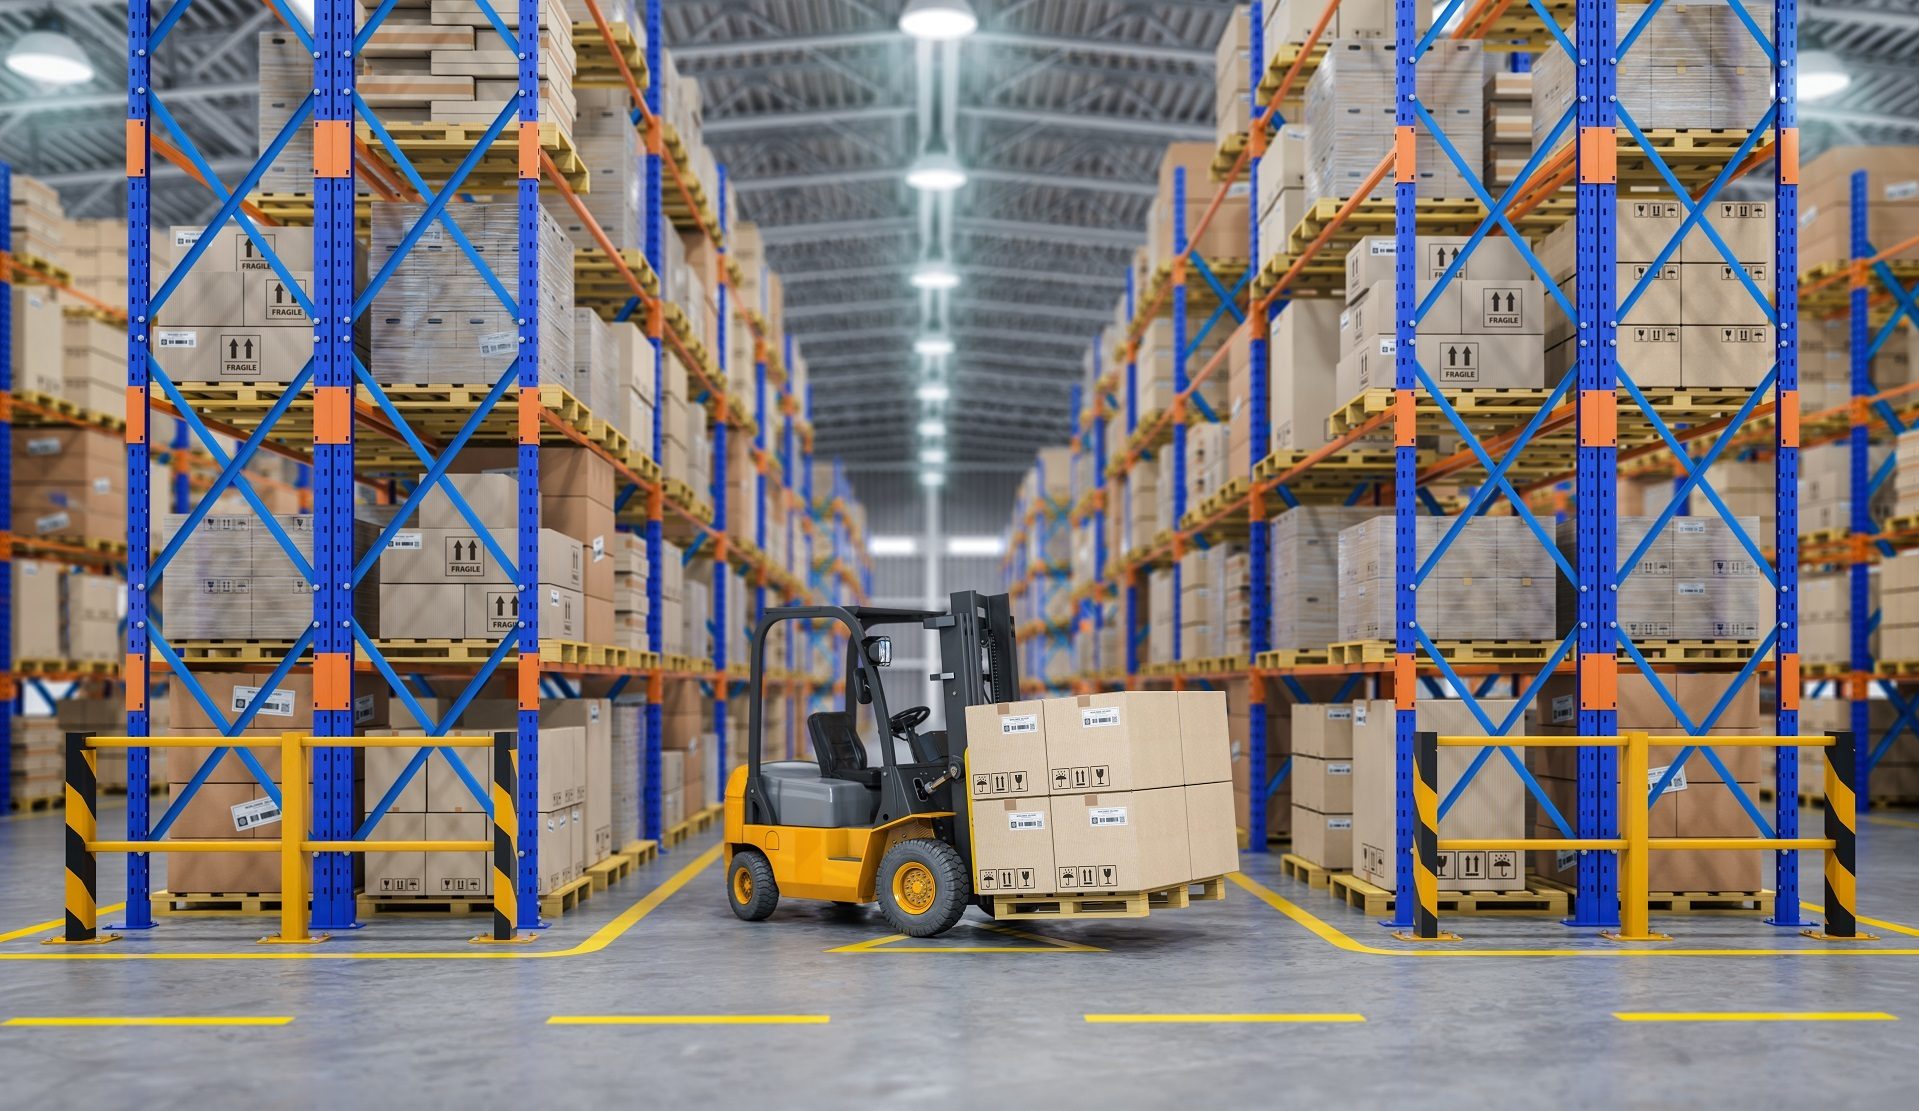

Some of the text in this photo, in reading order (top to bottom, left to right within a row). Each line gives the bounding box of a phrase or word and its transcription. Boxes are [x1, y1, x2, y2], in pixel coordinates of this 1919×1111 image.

[271, 308, 303, 316] FRAGILE
[1489, 316, 1519, 324] FRAGILE
[451, 565, 481, 573] FRAGILE
